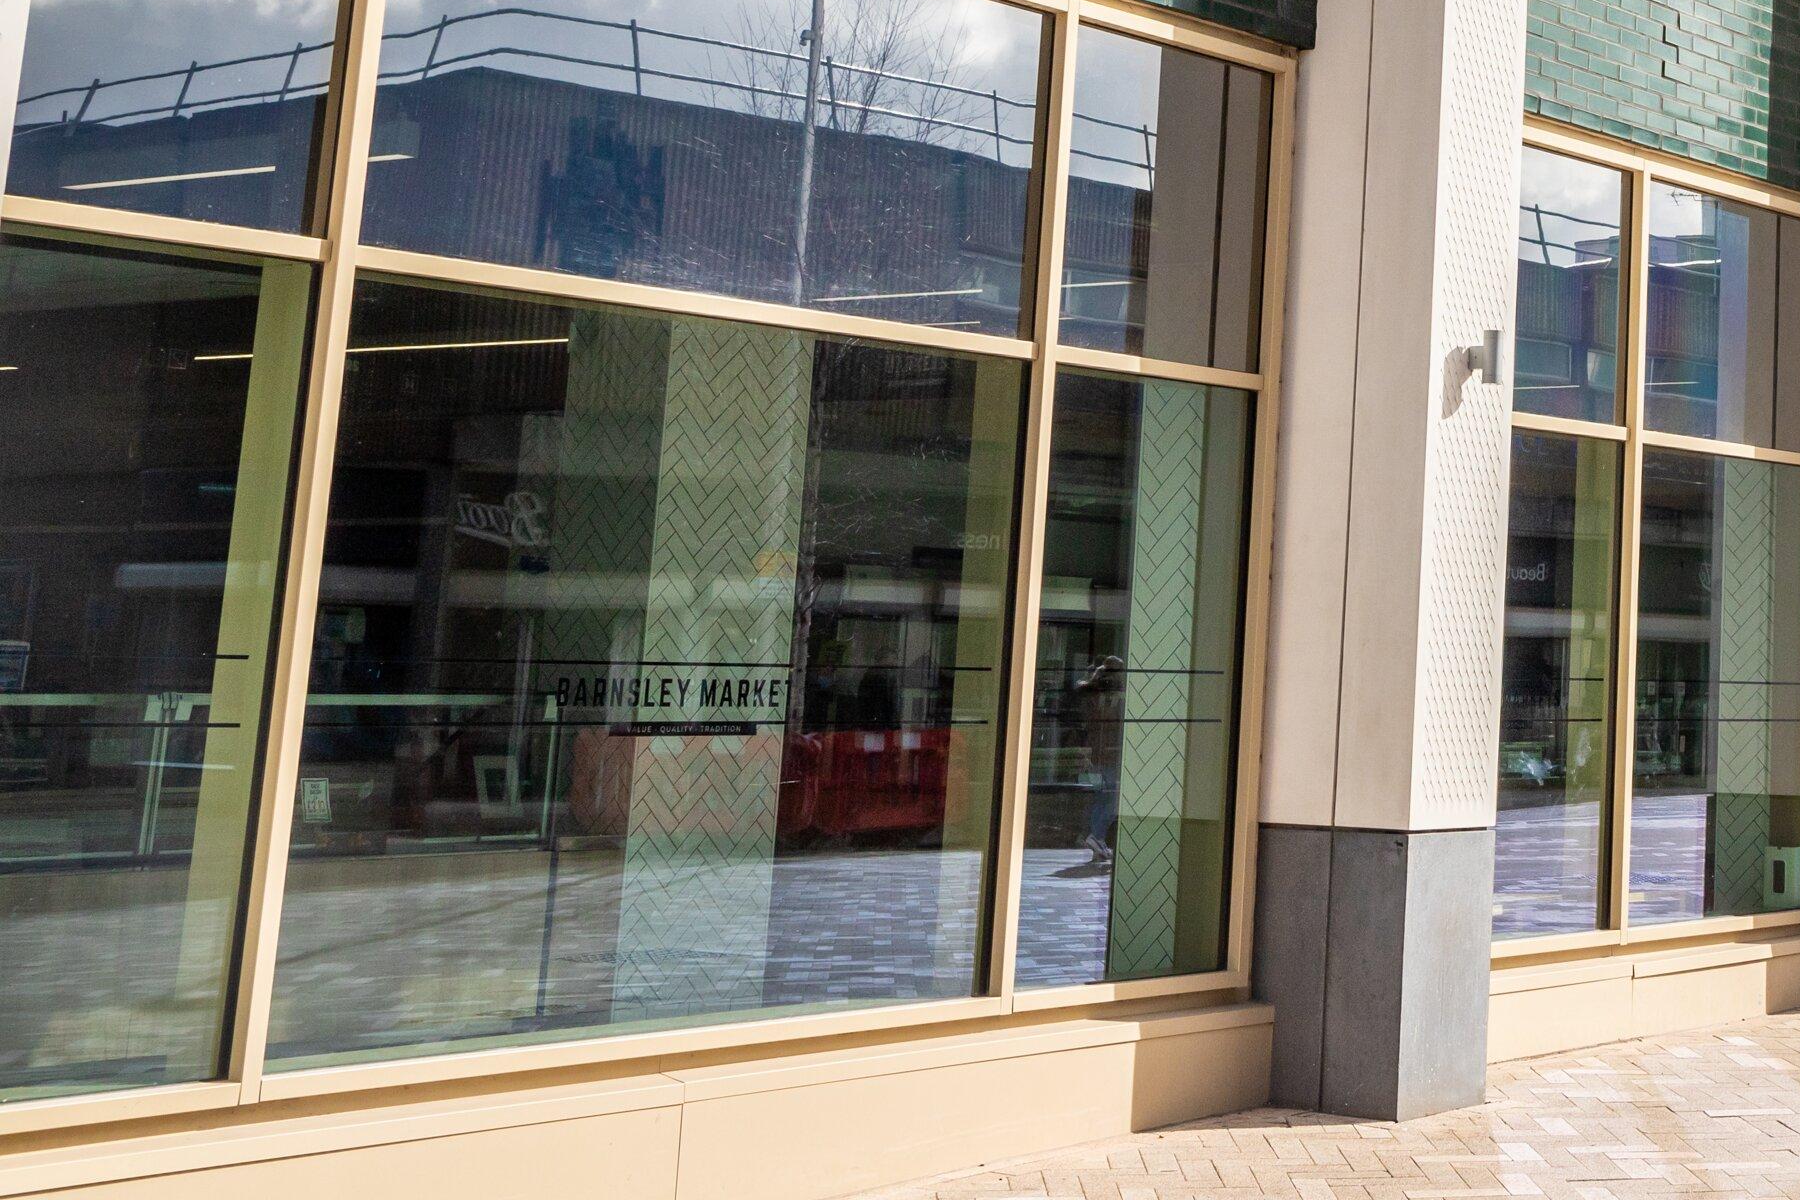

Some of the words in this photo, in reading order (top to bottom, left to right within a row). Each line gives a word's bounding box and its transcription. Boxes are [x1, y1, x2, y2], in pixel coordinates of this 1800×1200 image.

[556, 677, 691, 708] BARNSLEY
[626, 725, 652, 733] VALUE
[660, 725, 693, 733] QUALITY
